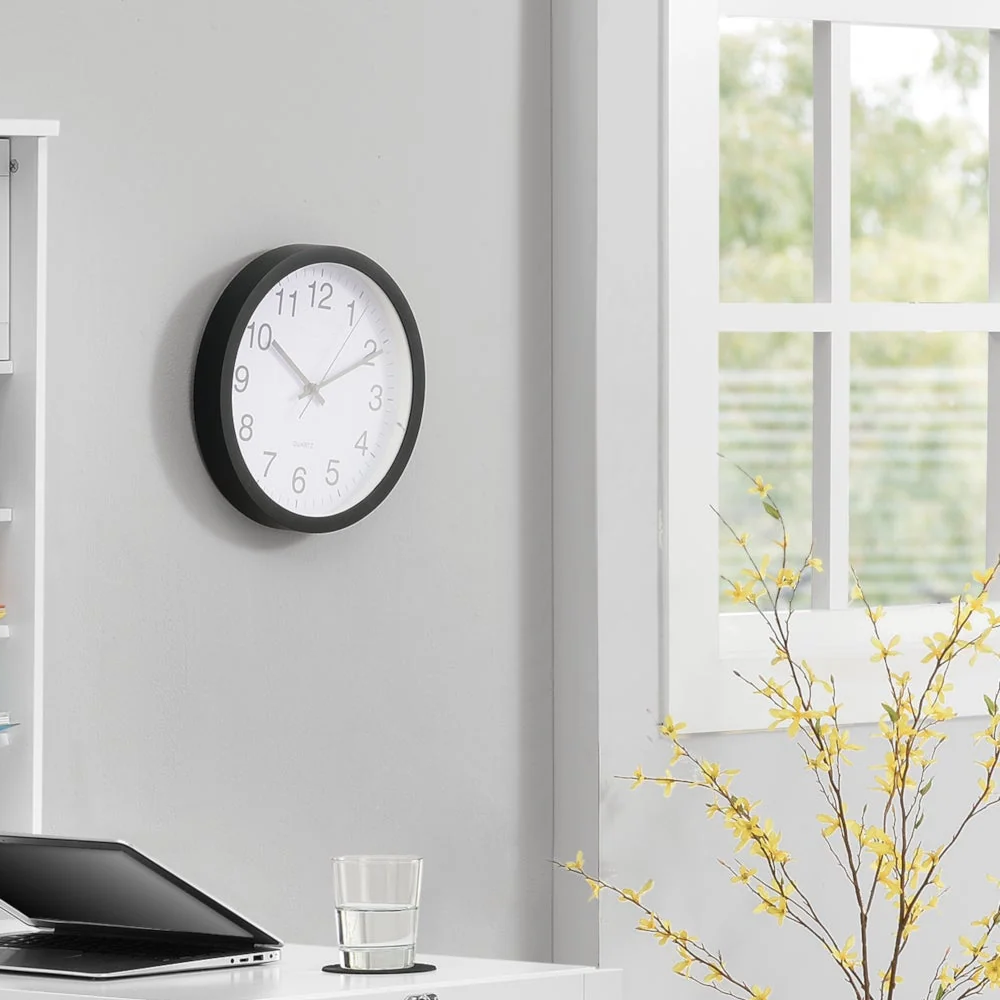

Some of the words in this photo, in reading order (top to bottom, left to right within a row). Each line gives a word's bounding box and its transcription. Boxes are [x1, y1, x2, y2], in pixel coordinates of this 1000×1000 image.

[275, 288, 298, 317] 11
[308, 281, 333, 310] 12
[347, 300, 356, 327] 1
[247, 321, 273, 351] 10
[363, 339, 378, 367] 2
[234, 365, 250, 393] 9
[368, 384, 383, 411] 3
[239, 414, 254, 442] 8
[354, 430, 369, 456] 4
[262, 451, 278, 478] 7
[325, 459, 340, 486] 5
[291, 466, 307, 494] 6
